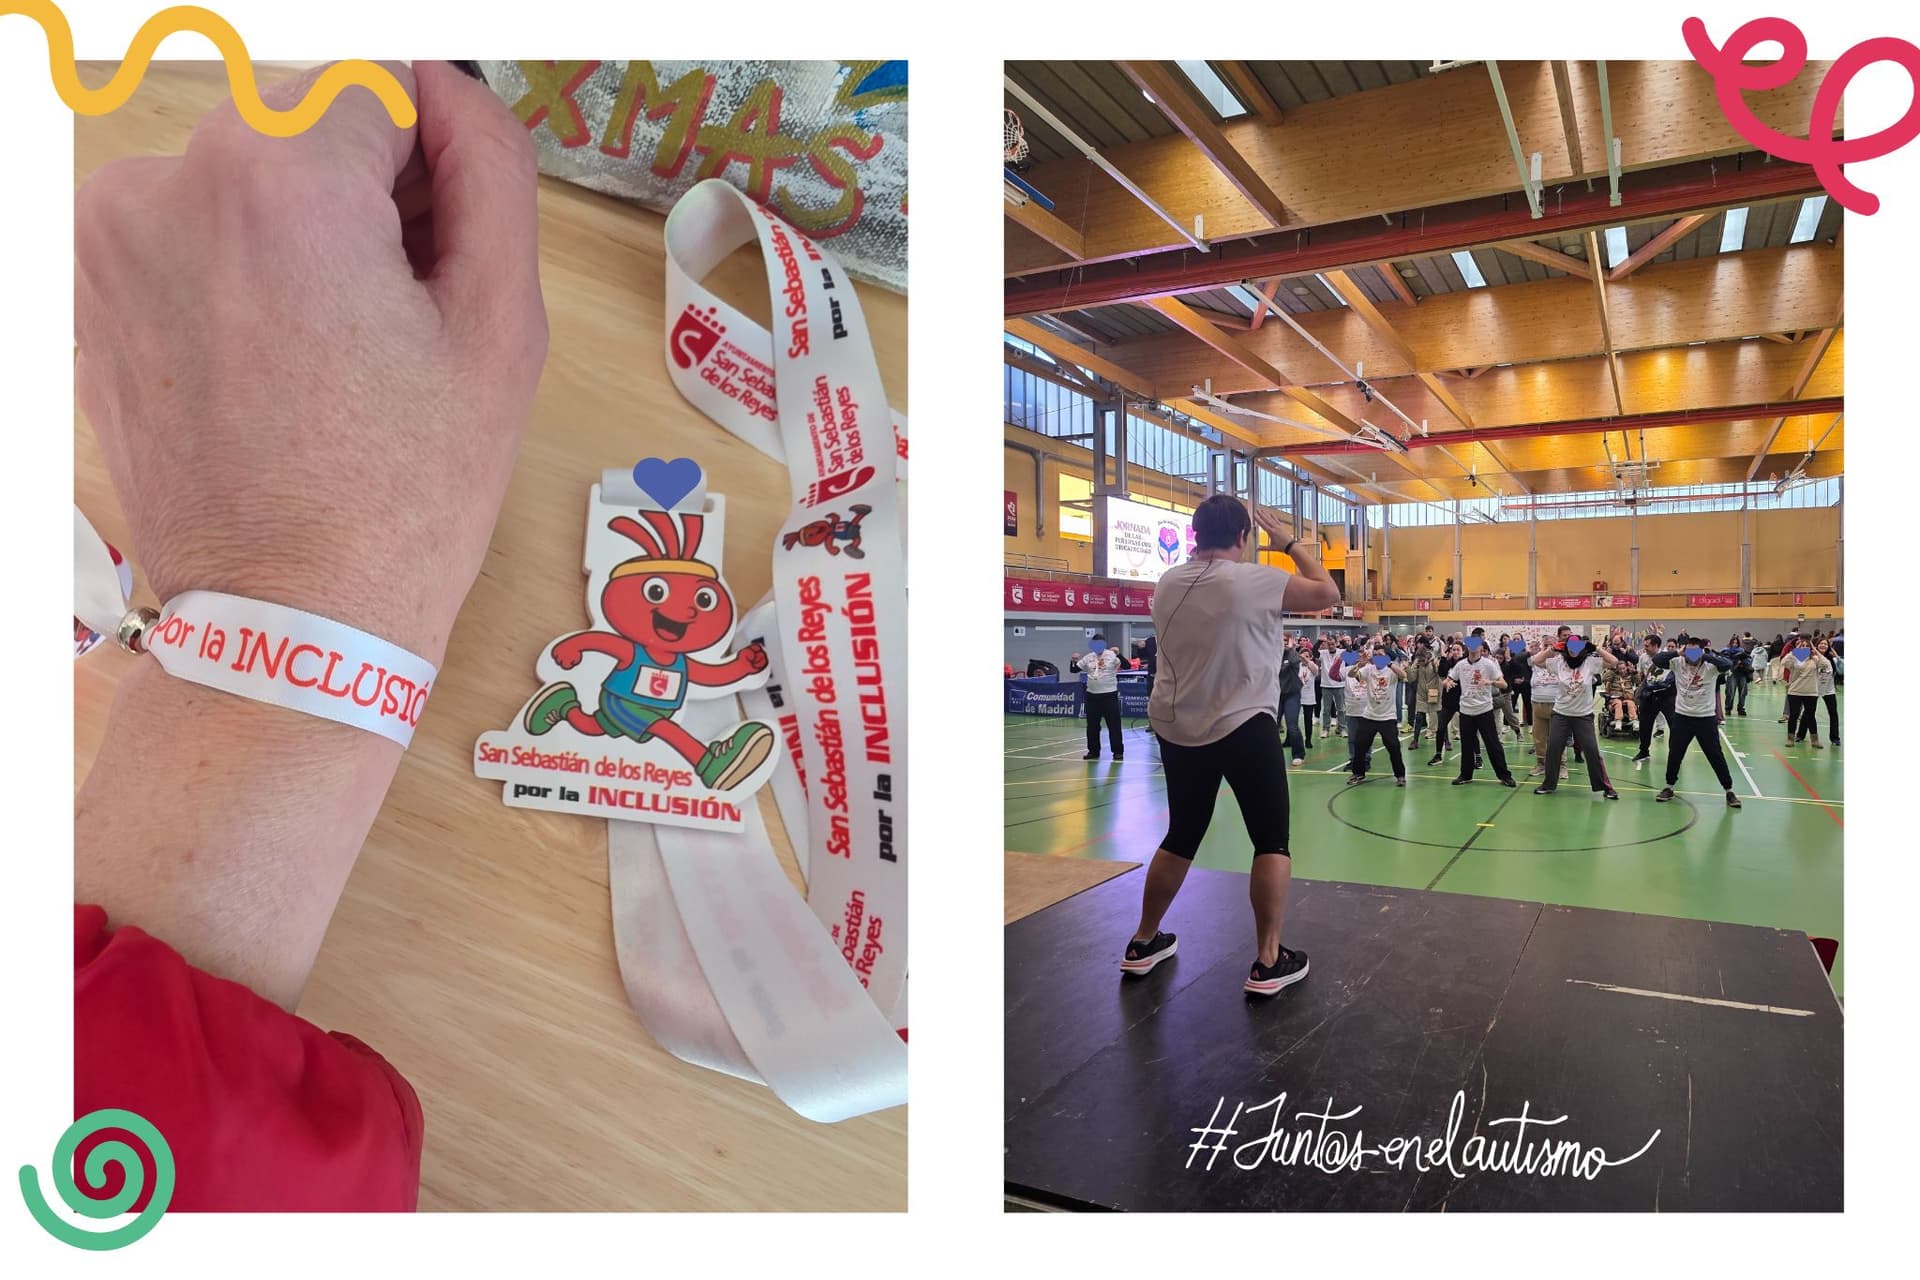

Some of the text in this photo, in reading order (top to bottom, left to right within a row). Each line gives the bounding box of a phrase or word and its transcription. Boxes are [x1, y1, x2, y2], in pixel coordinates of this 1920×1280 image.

[510, 60, 884, 240] XMAS
[770, 223, 807, 318] Sebastián
[821, 267, 848, 340] por la
[711, 349, 740, 377] San
[787, 318, 811, 360] San
[700, 366, 778, 422] de los Reyes
[836, 386, 859, 432] Reyes
[813, 374, 844, 474] San Sebastián
[198, 621, 226, 663] la
[766, 684, 785, 709] la
[797, 575, 851, 859] San Sebastián de los Reyes
[841, 572, 897, 863] por la INCLUSIÓN
[1025, 703, 1074, 715] de Madrid
[1026, 691, 1075, 702] Comunidad
[478, 742, 693, 790] San Sebastián de los Reyes
[513, 783, 742, 823] por la INCLUSIÓN
[841, 890, 865, 967] bastián
[855, 915, 883, 975] Reyes
